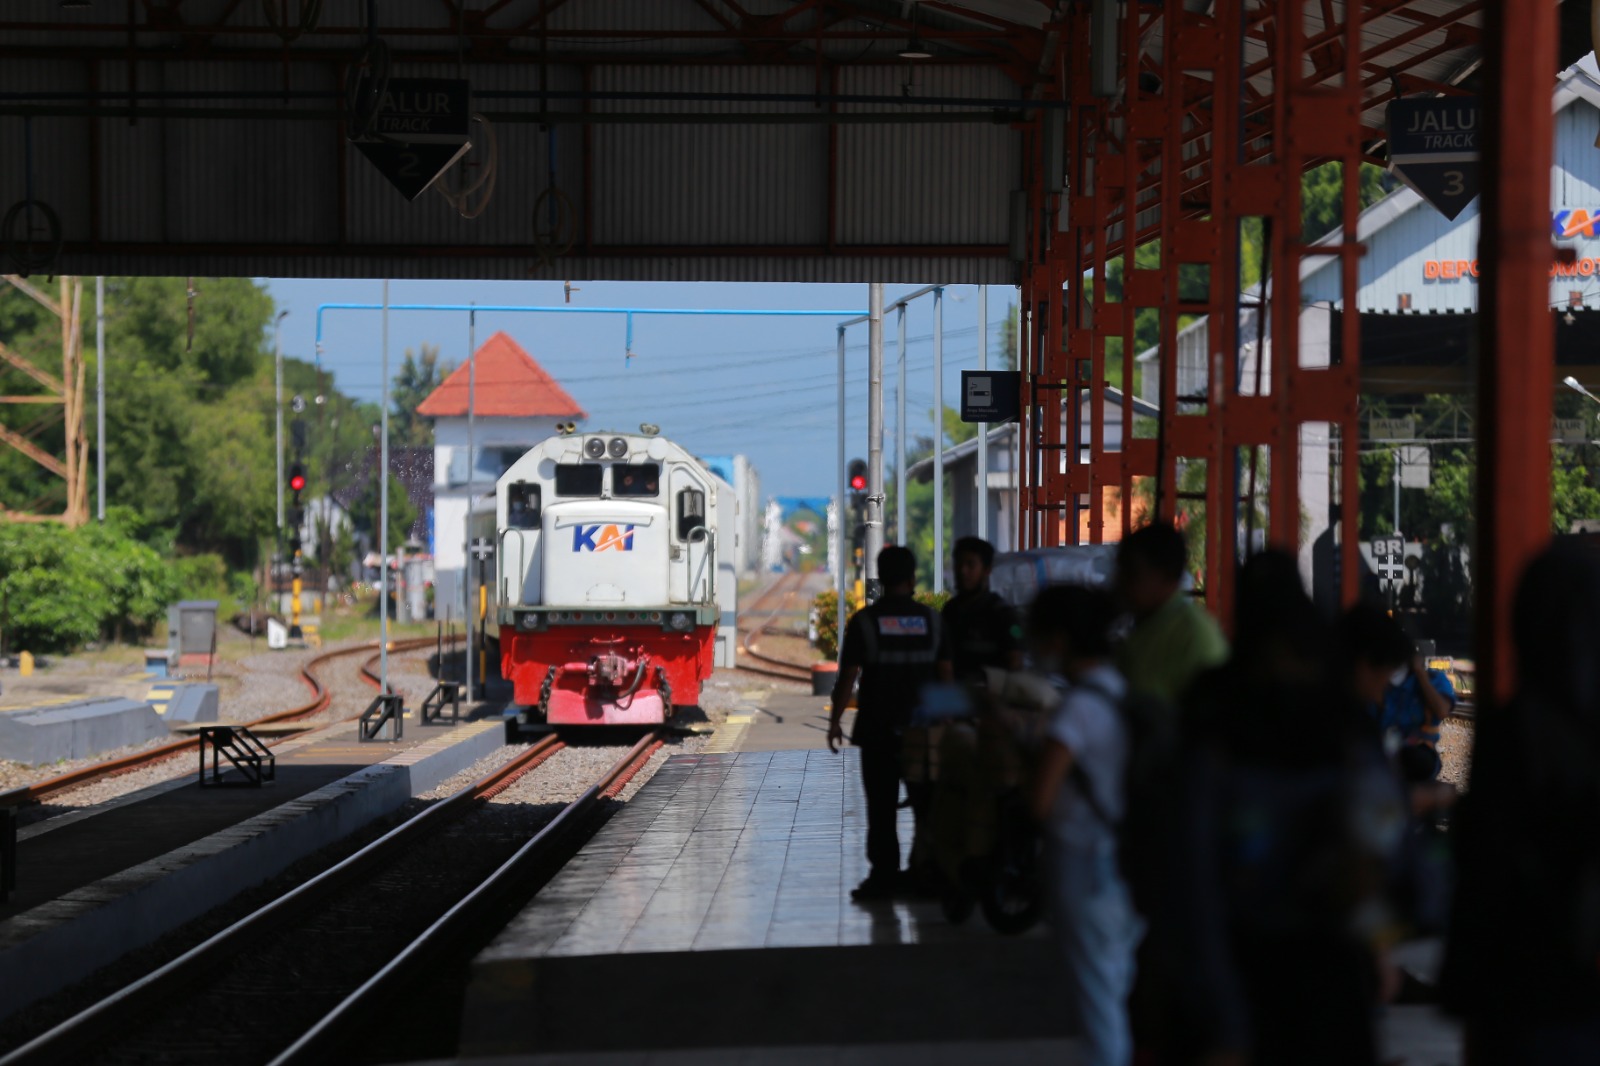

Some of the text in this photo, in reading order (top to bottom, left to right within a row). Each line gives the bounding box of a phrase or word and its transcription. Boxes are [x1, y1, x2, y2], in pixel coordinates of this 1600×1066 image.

[379, 91, 451, 113] ALUR
[382, 118, 432, 131] TRACK
[1407, 109, 1482, 132] JALU
[1424, 133, 1475, 149] TRACK
[398, 152, 420, 177] 2
[1442, 170, 1465, 196] 3
[571, 524, 634, 552] KAI
[1373, 539, 1402, 555] 8R
